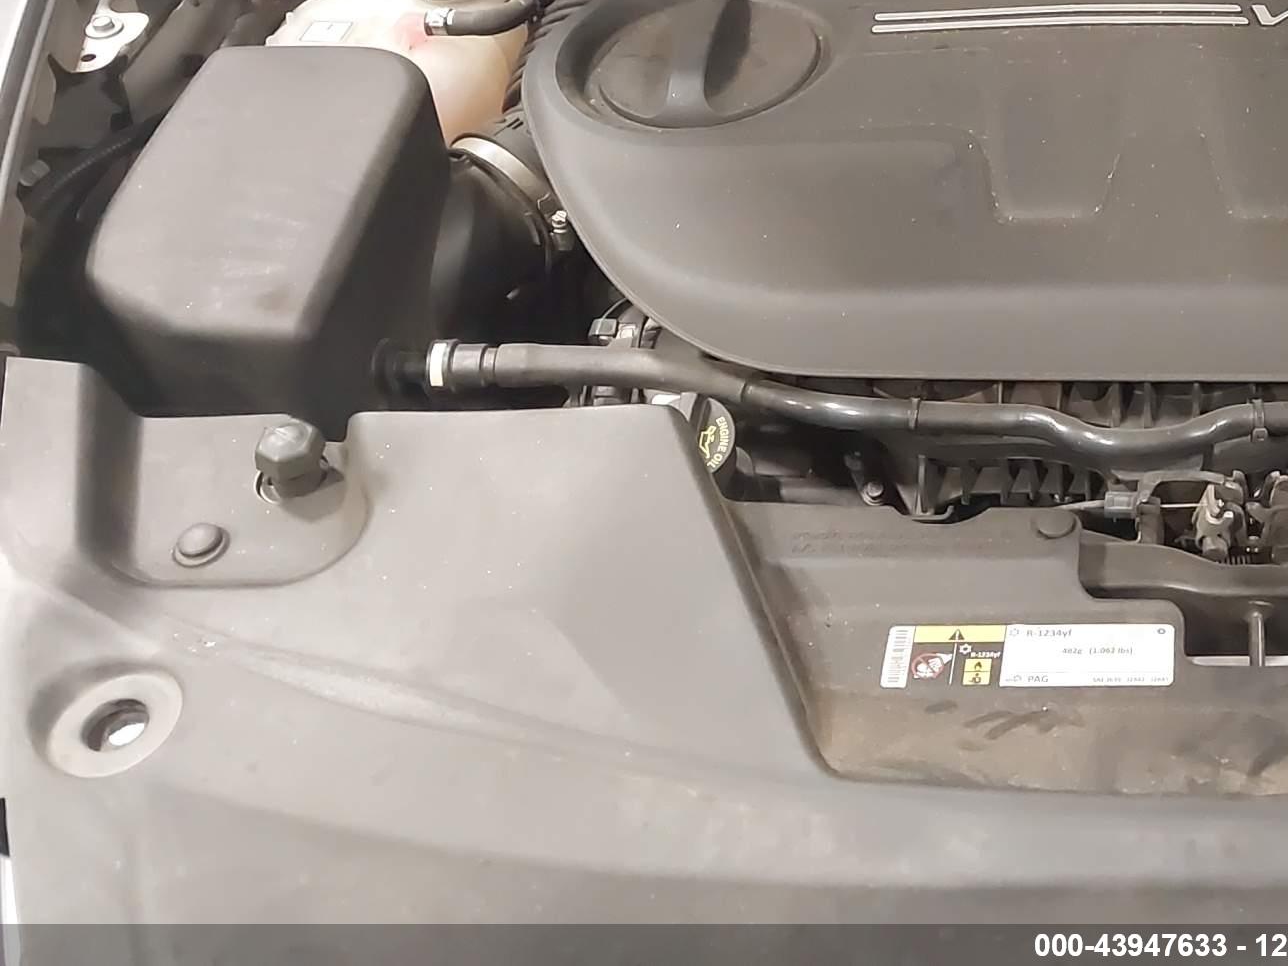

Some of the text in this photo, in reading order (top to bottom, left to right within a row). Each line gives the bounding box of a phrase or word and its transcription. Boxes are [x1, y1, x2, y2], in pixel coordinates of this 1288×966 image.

[707, 416, 729, 468] ENGINE OIL
[1027, 674, 1049, 683] PAG
